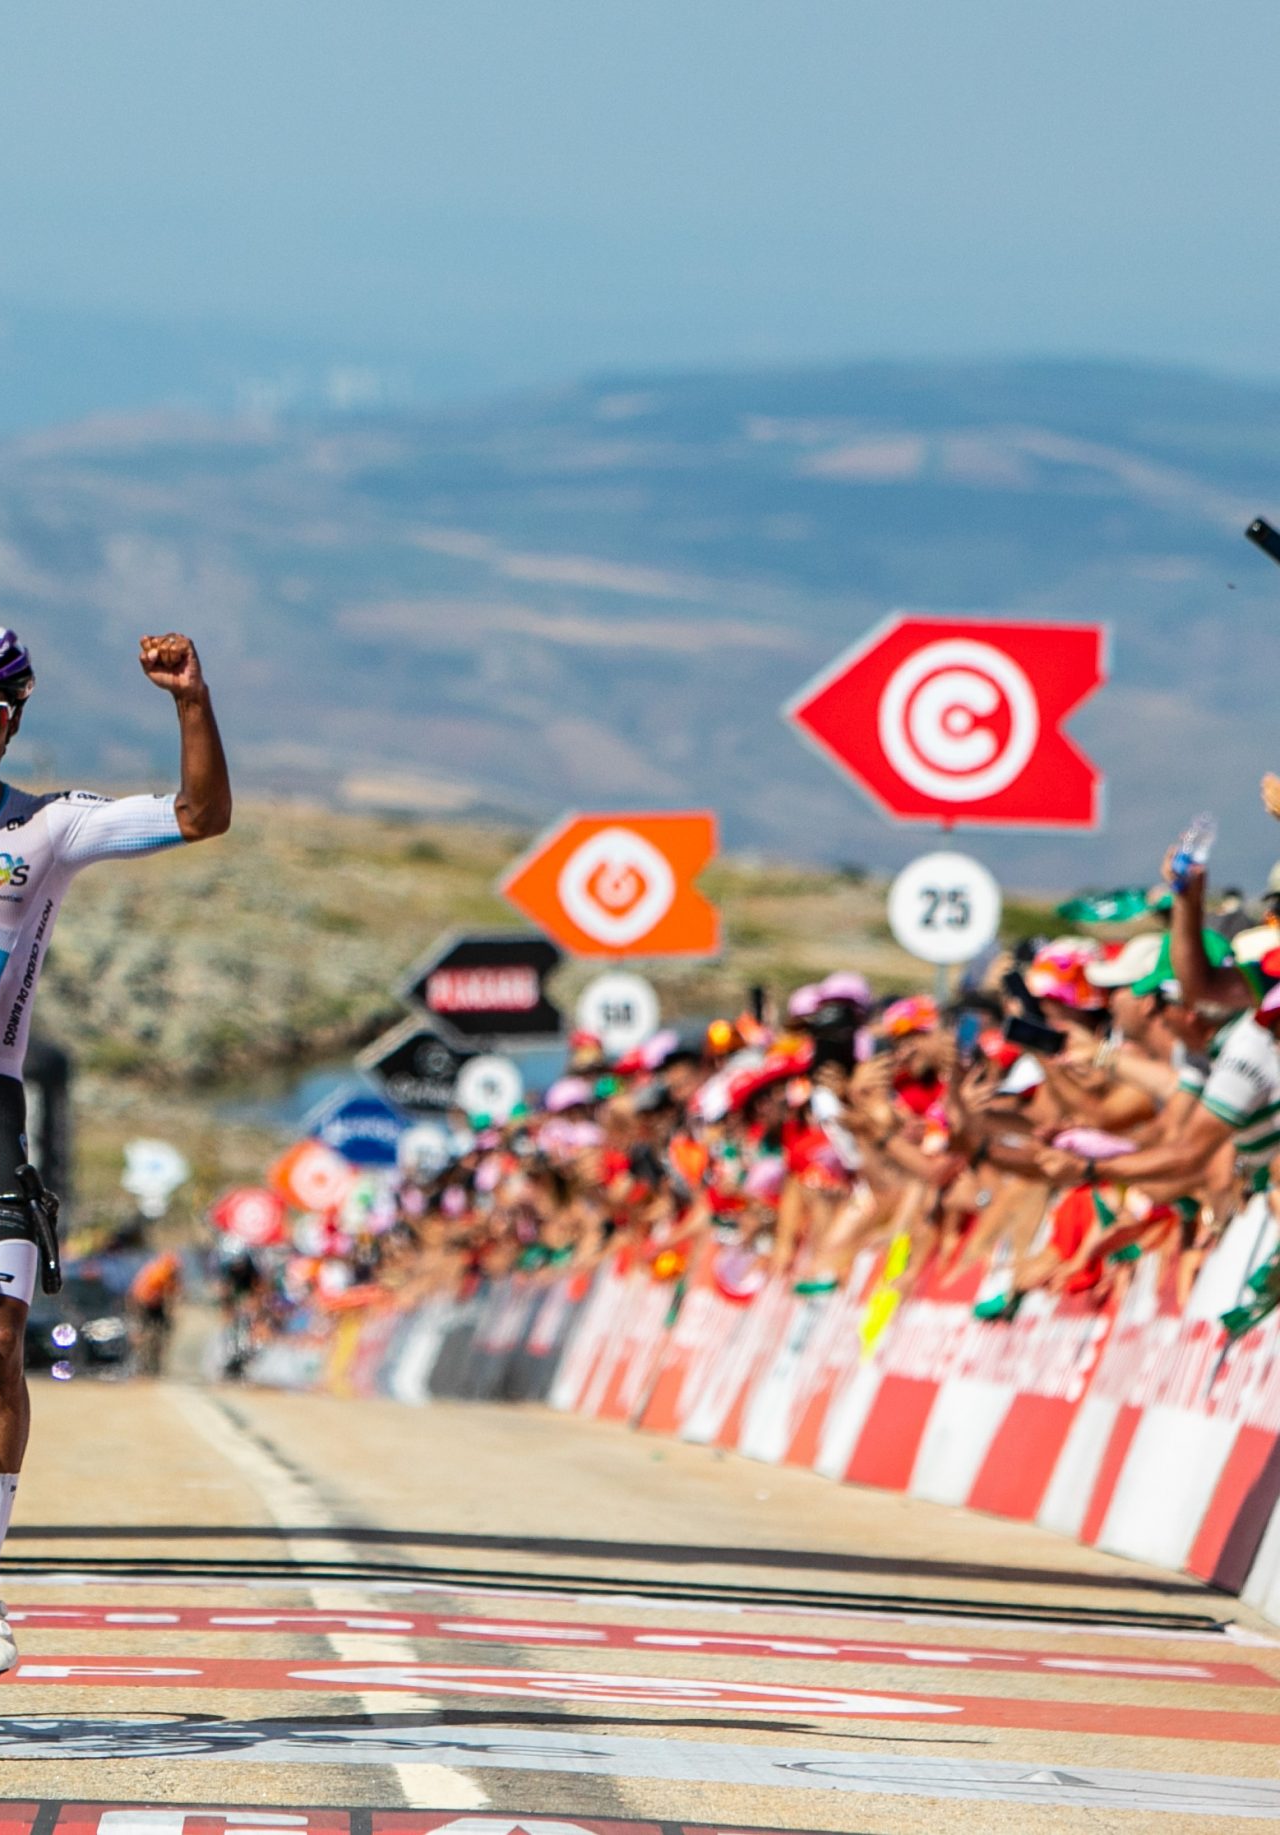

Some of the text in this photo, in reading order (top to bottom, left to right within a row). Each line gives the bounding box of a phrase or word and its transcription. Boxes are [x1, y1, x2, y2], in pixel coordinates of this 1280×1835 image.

[921, 888, 971, 927] 25
[2, 898, 55, 1048] HOTEL CIUDAD DE BURGOS
